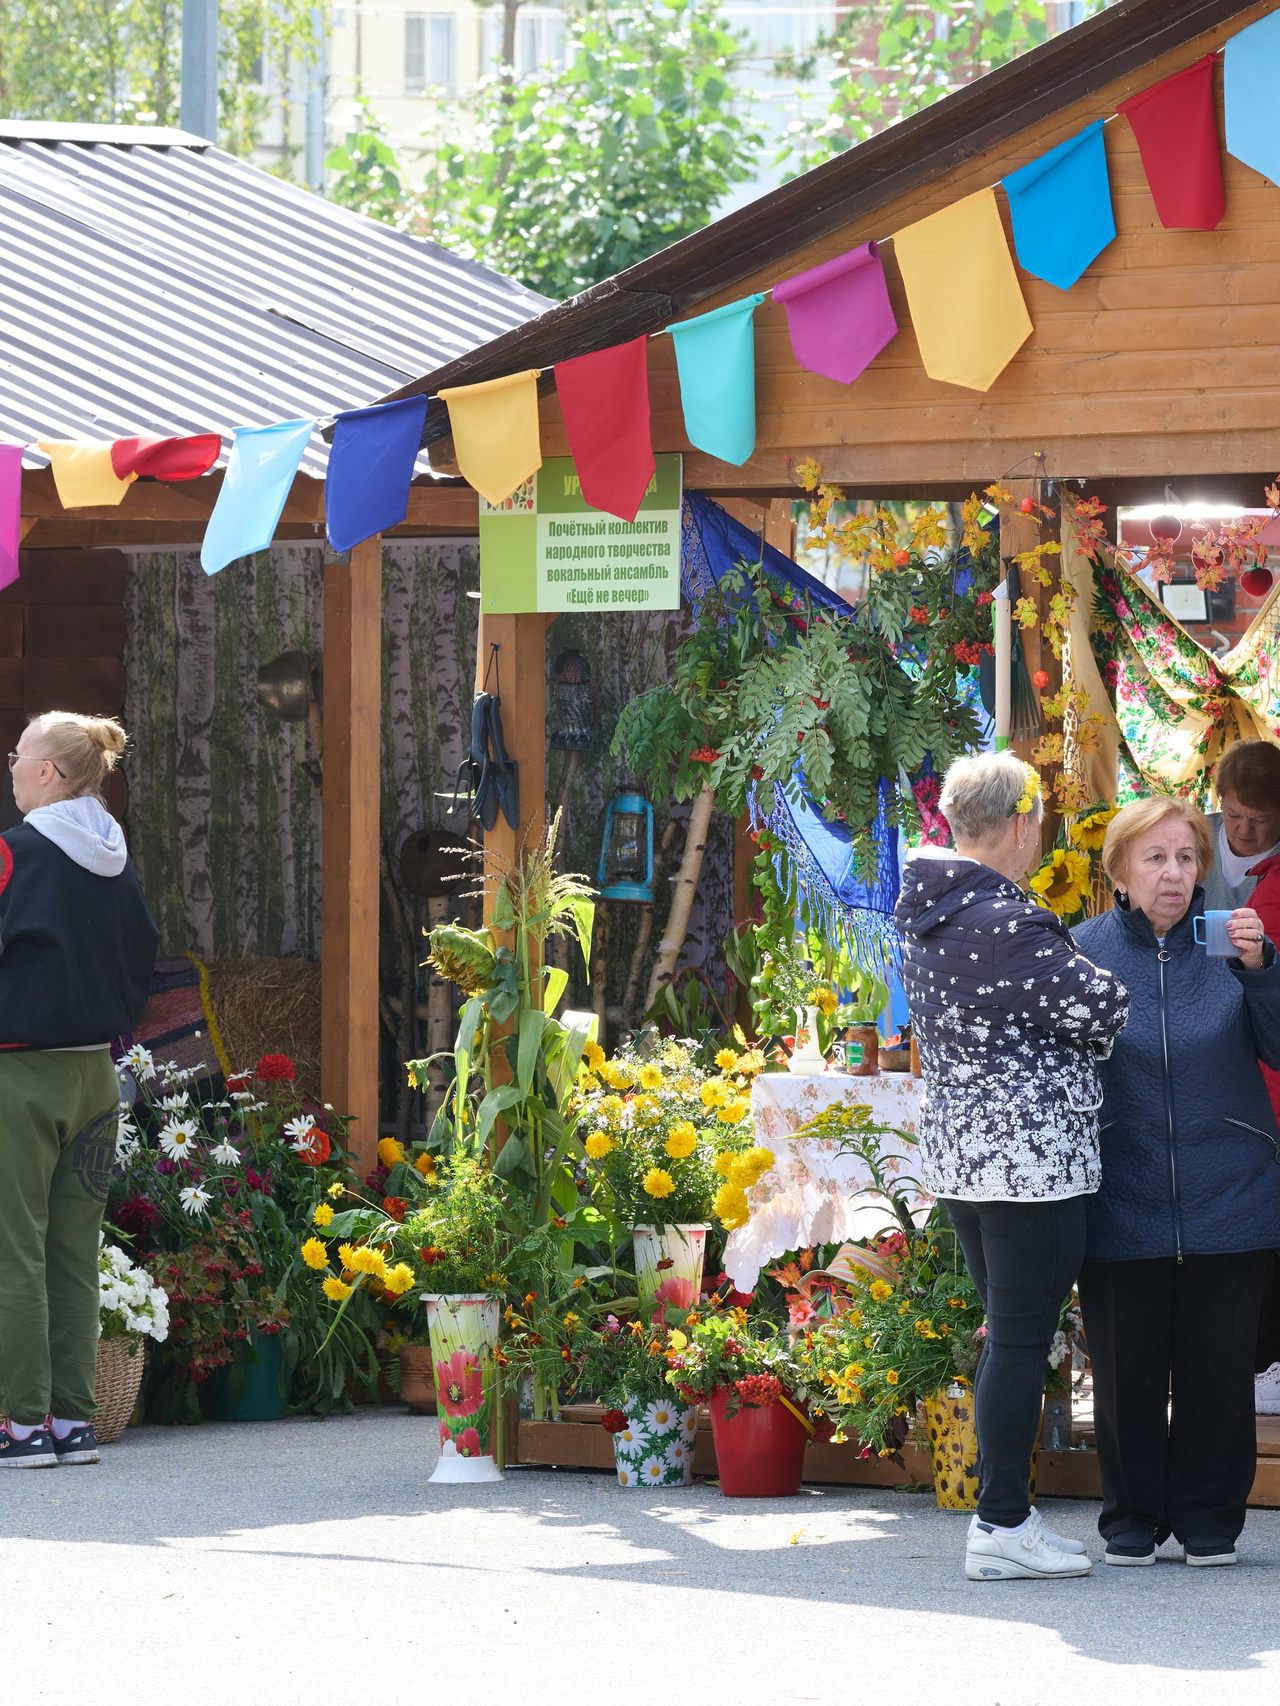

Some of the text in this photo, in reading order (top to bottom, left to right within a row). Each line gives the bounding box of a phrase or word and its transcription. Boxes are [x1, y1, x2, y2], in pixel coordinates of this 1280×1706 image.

[549, 519, 669, 537] Почётный коллектив
[545, 543, 671, 560] народного творчества
[546, 563, 669, 582] вокальный ансамбль
[566, 587, 649, 605] «Ещё не вечер»
